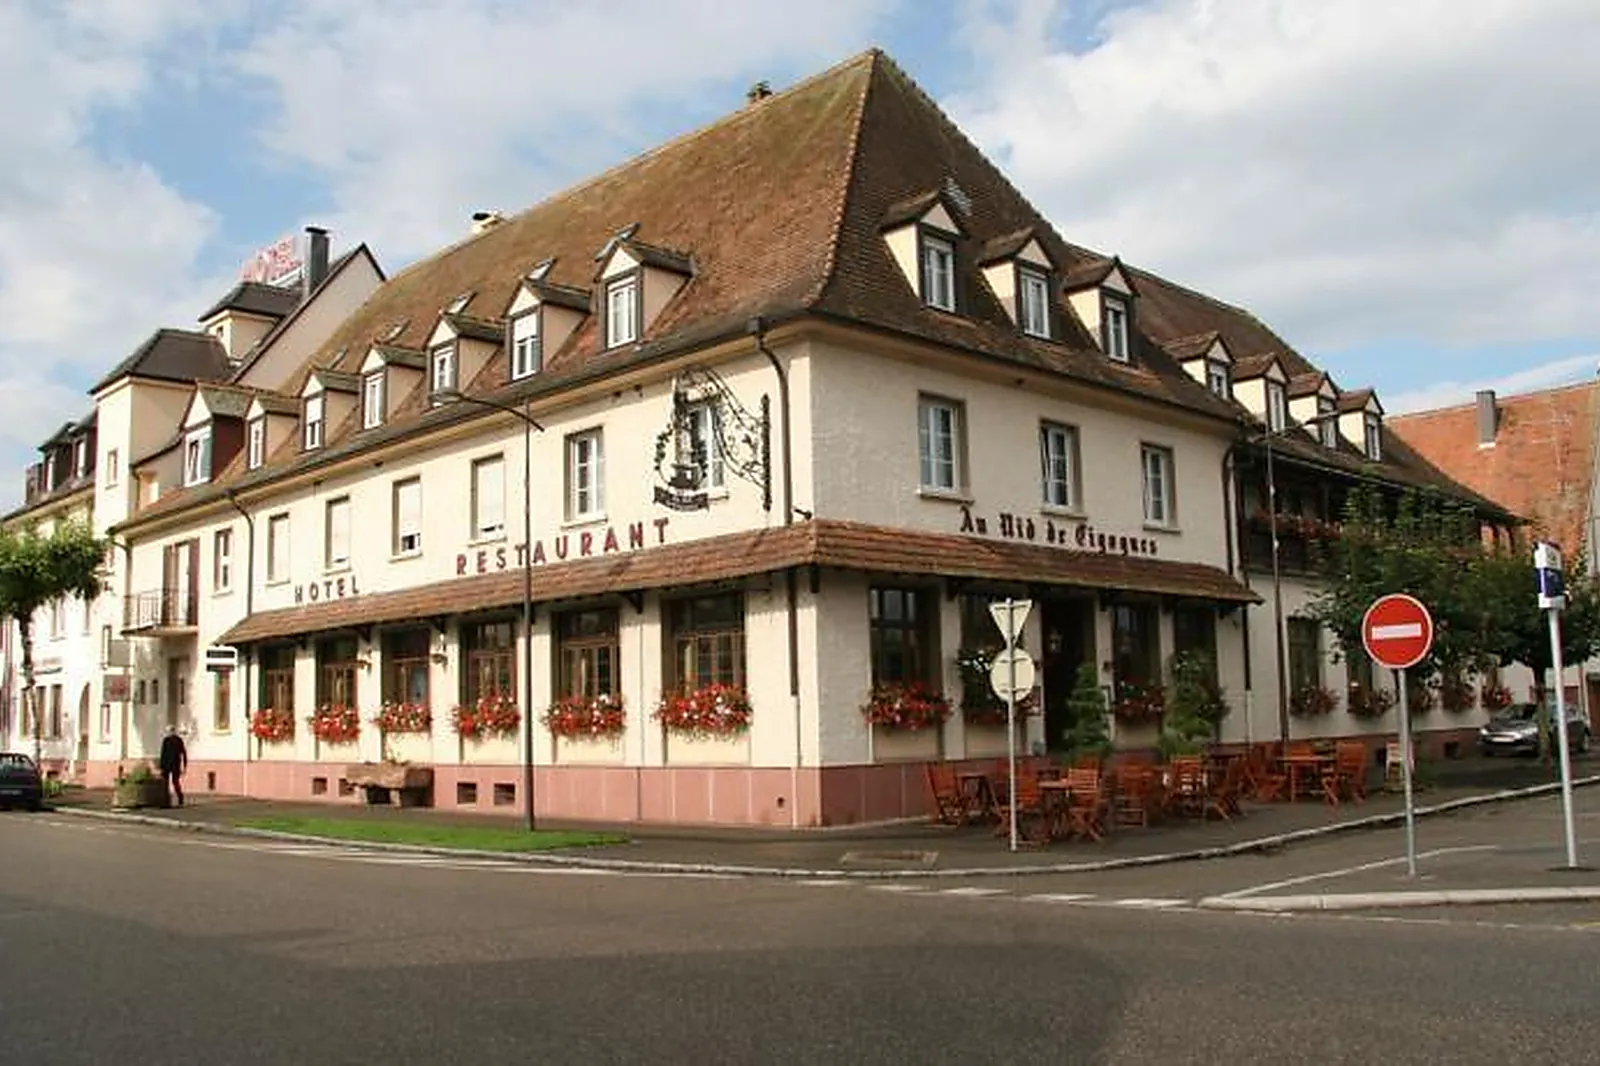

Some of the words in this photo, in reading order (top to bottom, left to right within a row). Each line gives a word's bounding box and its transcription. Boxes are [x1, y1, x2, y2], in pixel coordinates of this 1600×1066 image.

[960, 506, 987, 535] Au
[1000, 512, 1035, 541] Nid
[1047, 521, 1066, 544] de
[295, 575, 360, 603] HOTEL
[456, 517, 670, 575] RESTAURANT
